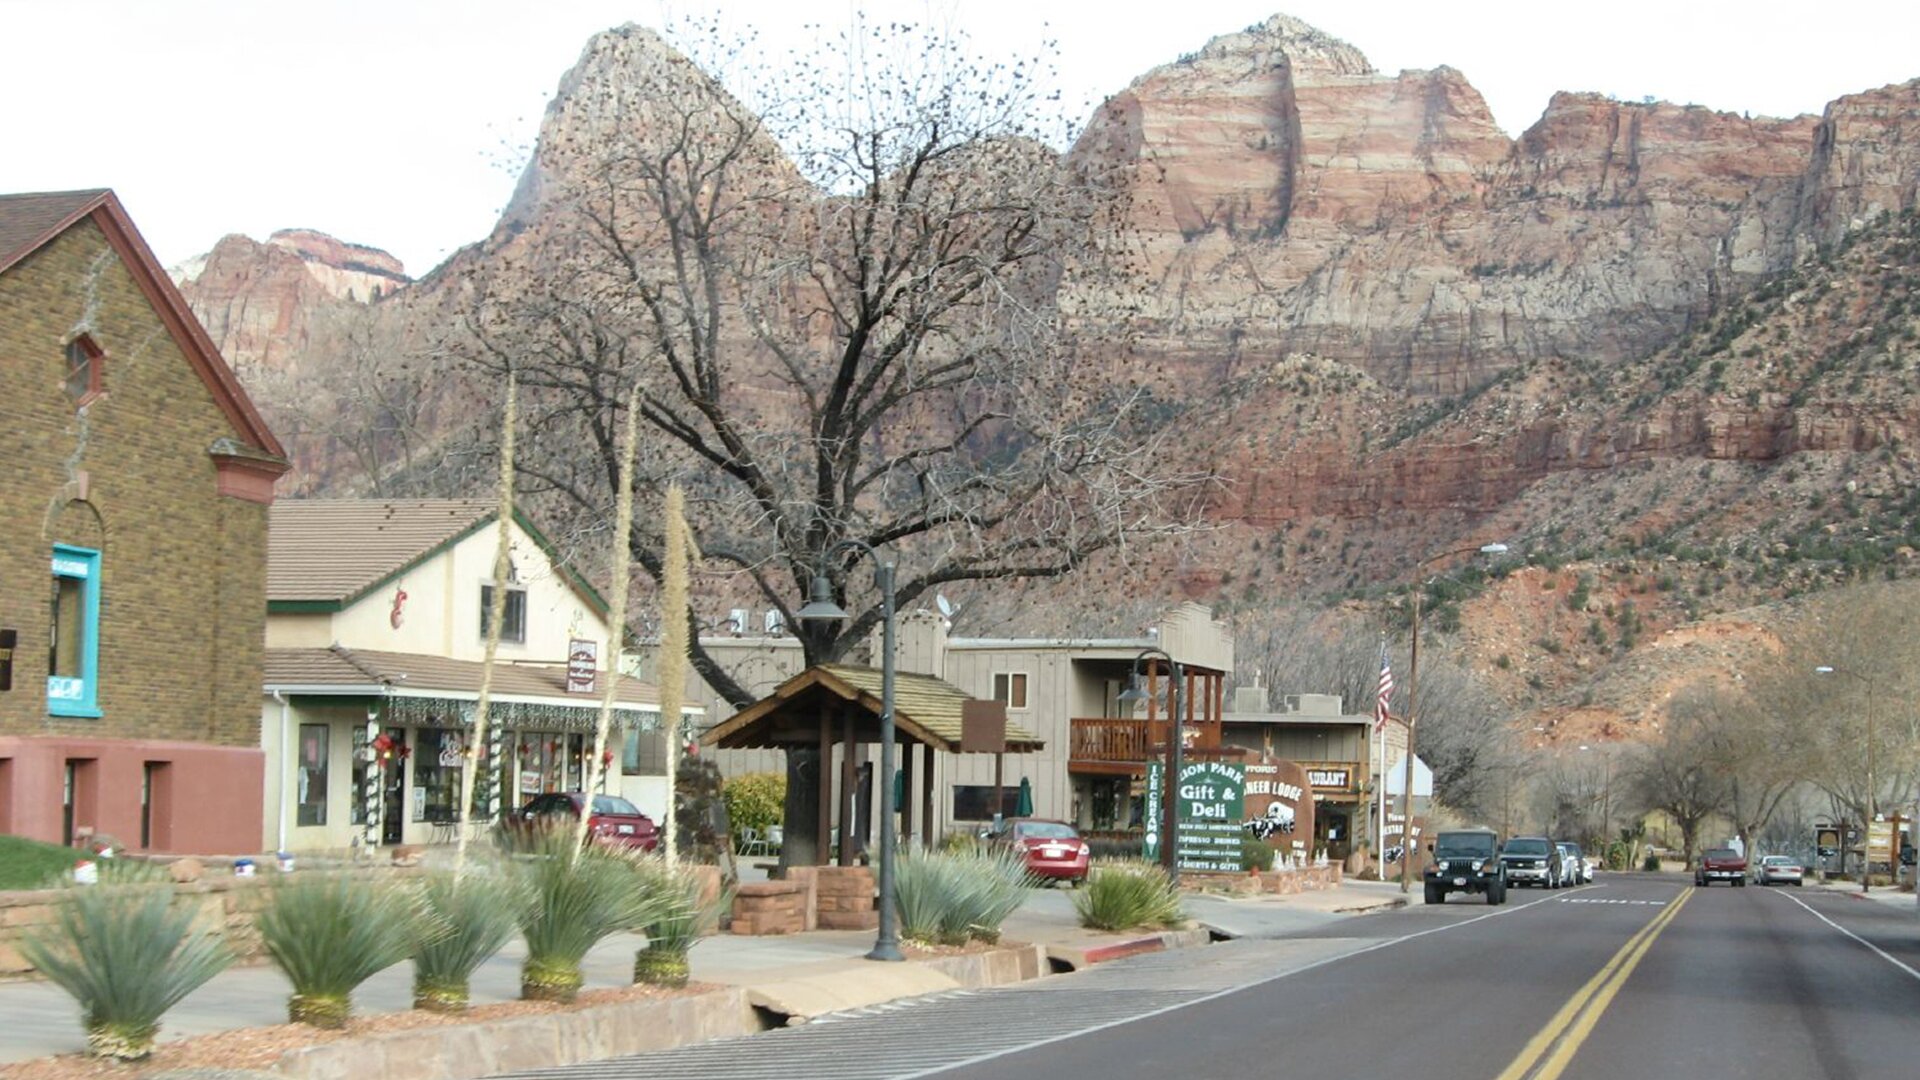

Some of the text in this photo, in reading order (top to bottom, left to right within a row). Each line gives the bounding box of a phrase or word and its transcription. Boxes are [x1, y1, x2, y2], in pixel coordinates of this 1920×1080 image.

[1211, 763, 1244, 784] PARK
[1245, 765, 1278, 774] TORIC
[1147, 765, 1159, 832] ICE CREAM
[1180, 784, 1236, 801] Gift &
[1243, 780, 1303, 802] NEER LODGE
[1191, 802, 1226, 818] Deli
